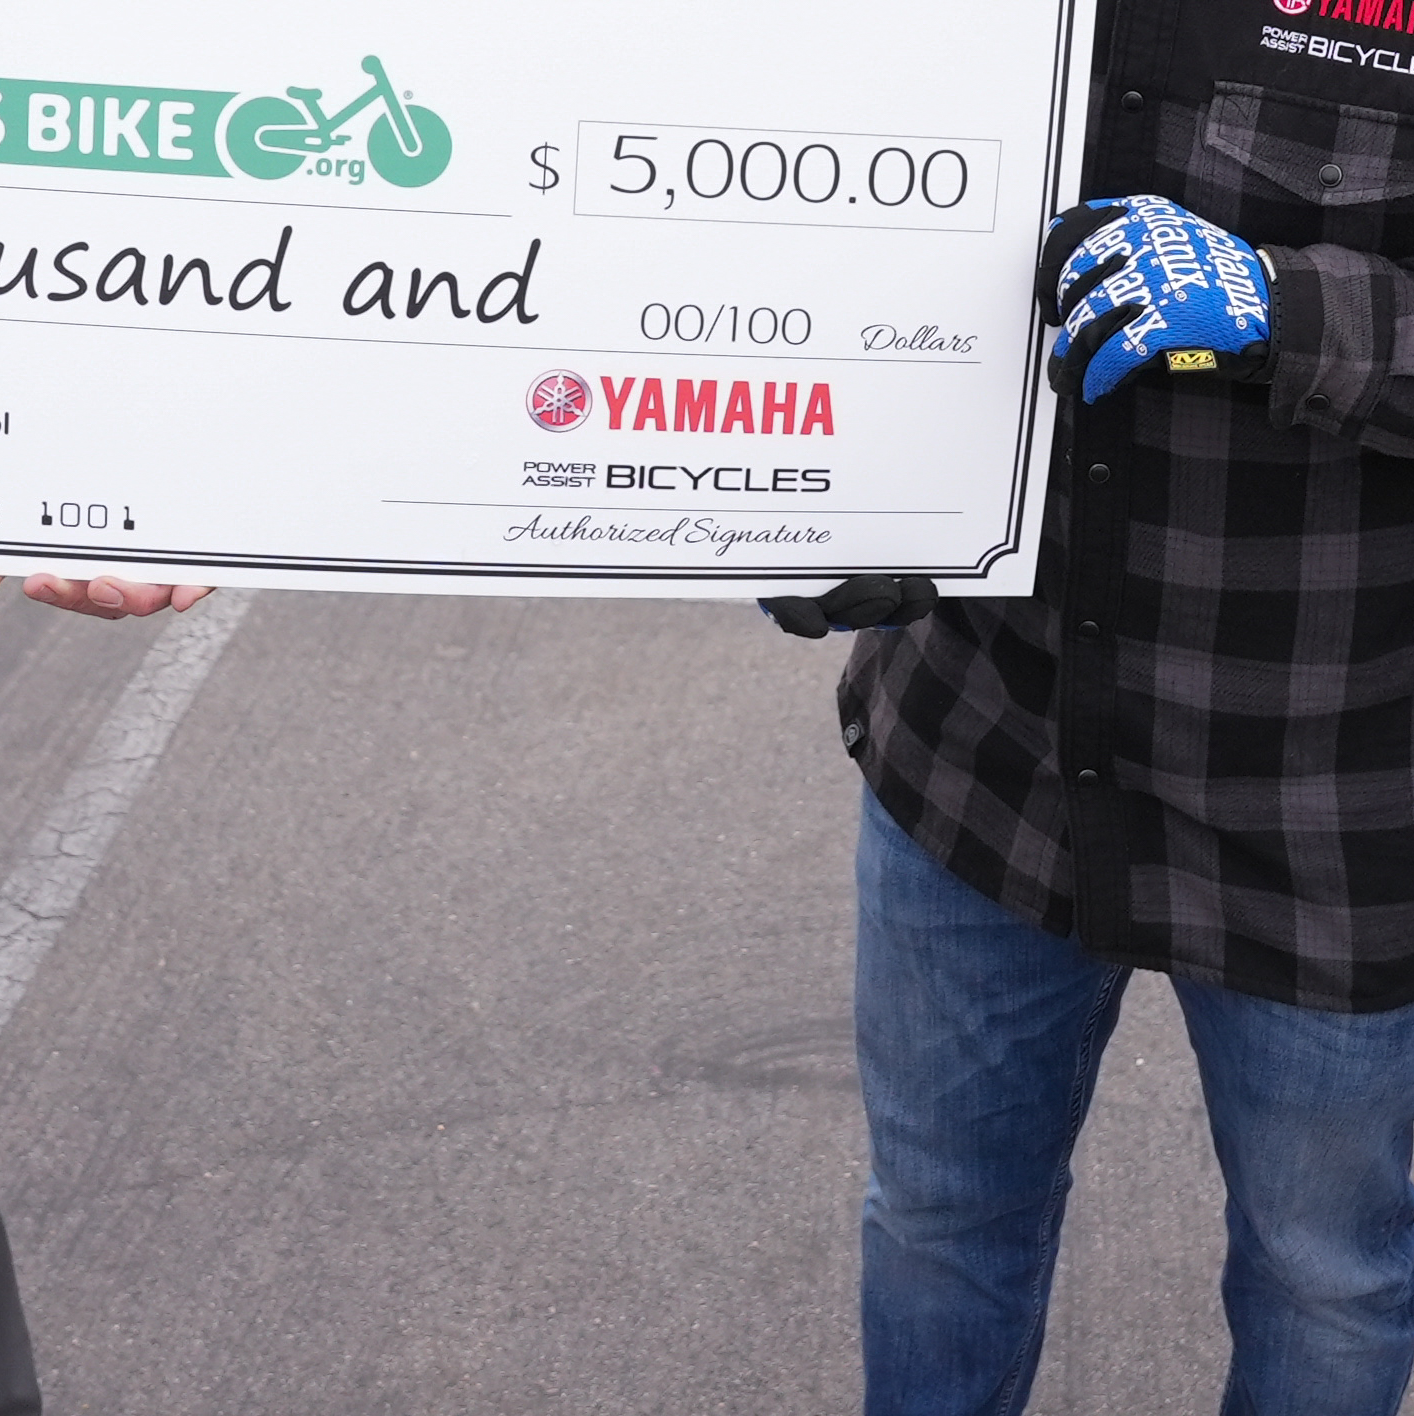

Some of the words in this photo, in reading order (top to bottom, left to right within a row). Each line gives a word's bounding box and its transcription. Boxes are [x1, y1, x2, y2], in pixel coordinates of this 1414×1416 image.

[1261, 37, 1304, 53] ASSIST
[1263, 26, 1308, 43] POWER
[28, 93, 194, 160] BIKE
[307, 158, 365, 185] .org
[611, 135, 967, 209] 5,000.00
[1128, 194, 1212, 290] echanix
[343, 239, 541, 324] and
[1193, 218, 1269, 324] echanix
[641, 303, 811, 345] 00/100
[861, 325, 977, 353] Dollars
[601, 377, 834, 435] YAMAHA
[522, 476, 595, 487] ASSIST
[524, 462, 596, 474] POWER
[607, 465, 830, 492] BICYCLES
[42, 502, 134, 530] 1001
[504, 513, 683, 546] Authorized
[686, 518, 831, 554] Signature
